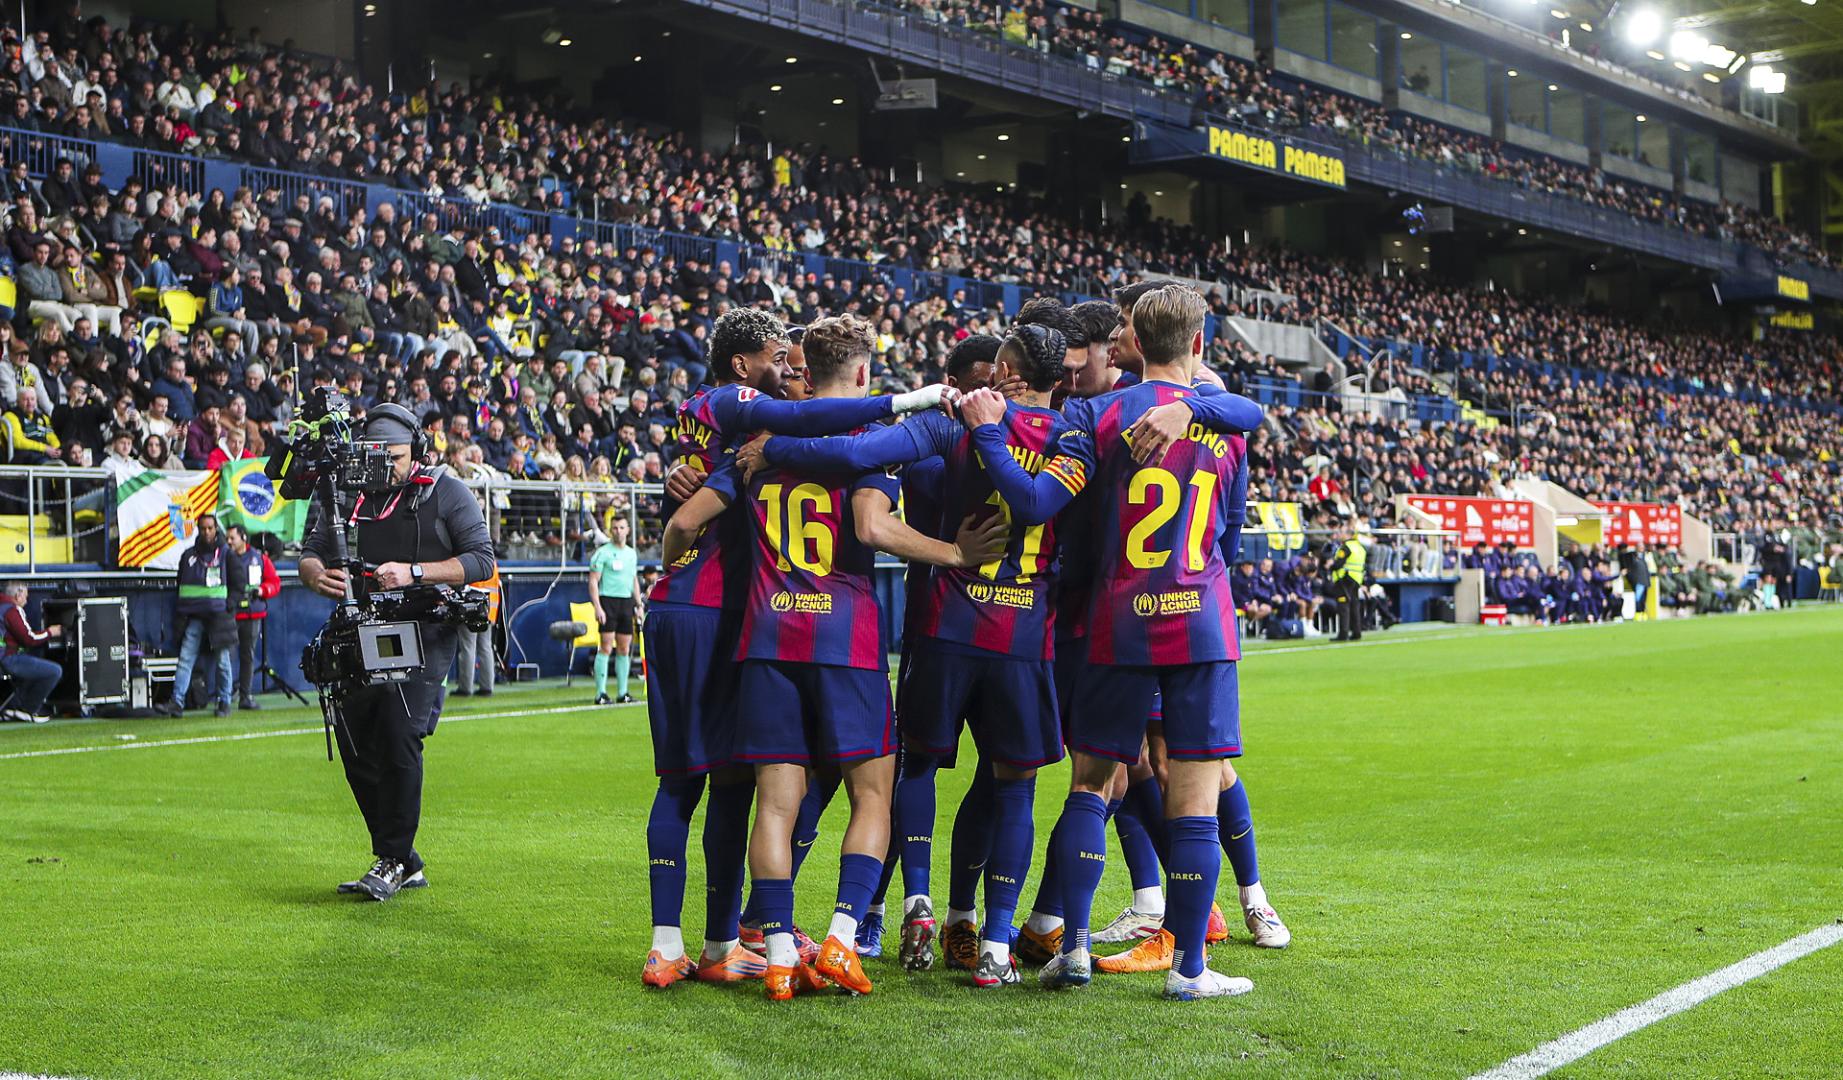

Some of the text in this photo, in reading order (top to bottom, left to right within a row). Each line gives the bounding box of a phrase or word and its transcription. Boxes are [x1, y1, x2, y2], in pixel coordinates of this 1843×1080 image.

[1209, 126, 1346, 187] PAMESA PAMESA
[1180, 422, 1229, 459] ONG
[1126, 467, 1217, 571] 21
[758, 482, 833, 577] 16
[795, 592, 832, 602] UNHCR
[994, 585, 1034, 598] UNHCR
[1159, 591, 1199, 603] UNHCR
[795, 600, 832, 610] ACNUR
[993, 593, 1034, 607] ACNUR
[1160, 599, 1201, 611] ACNUR
